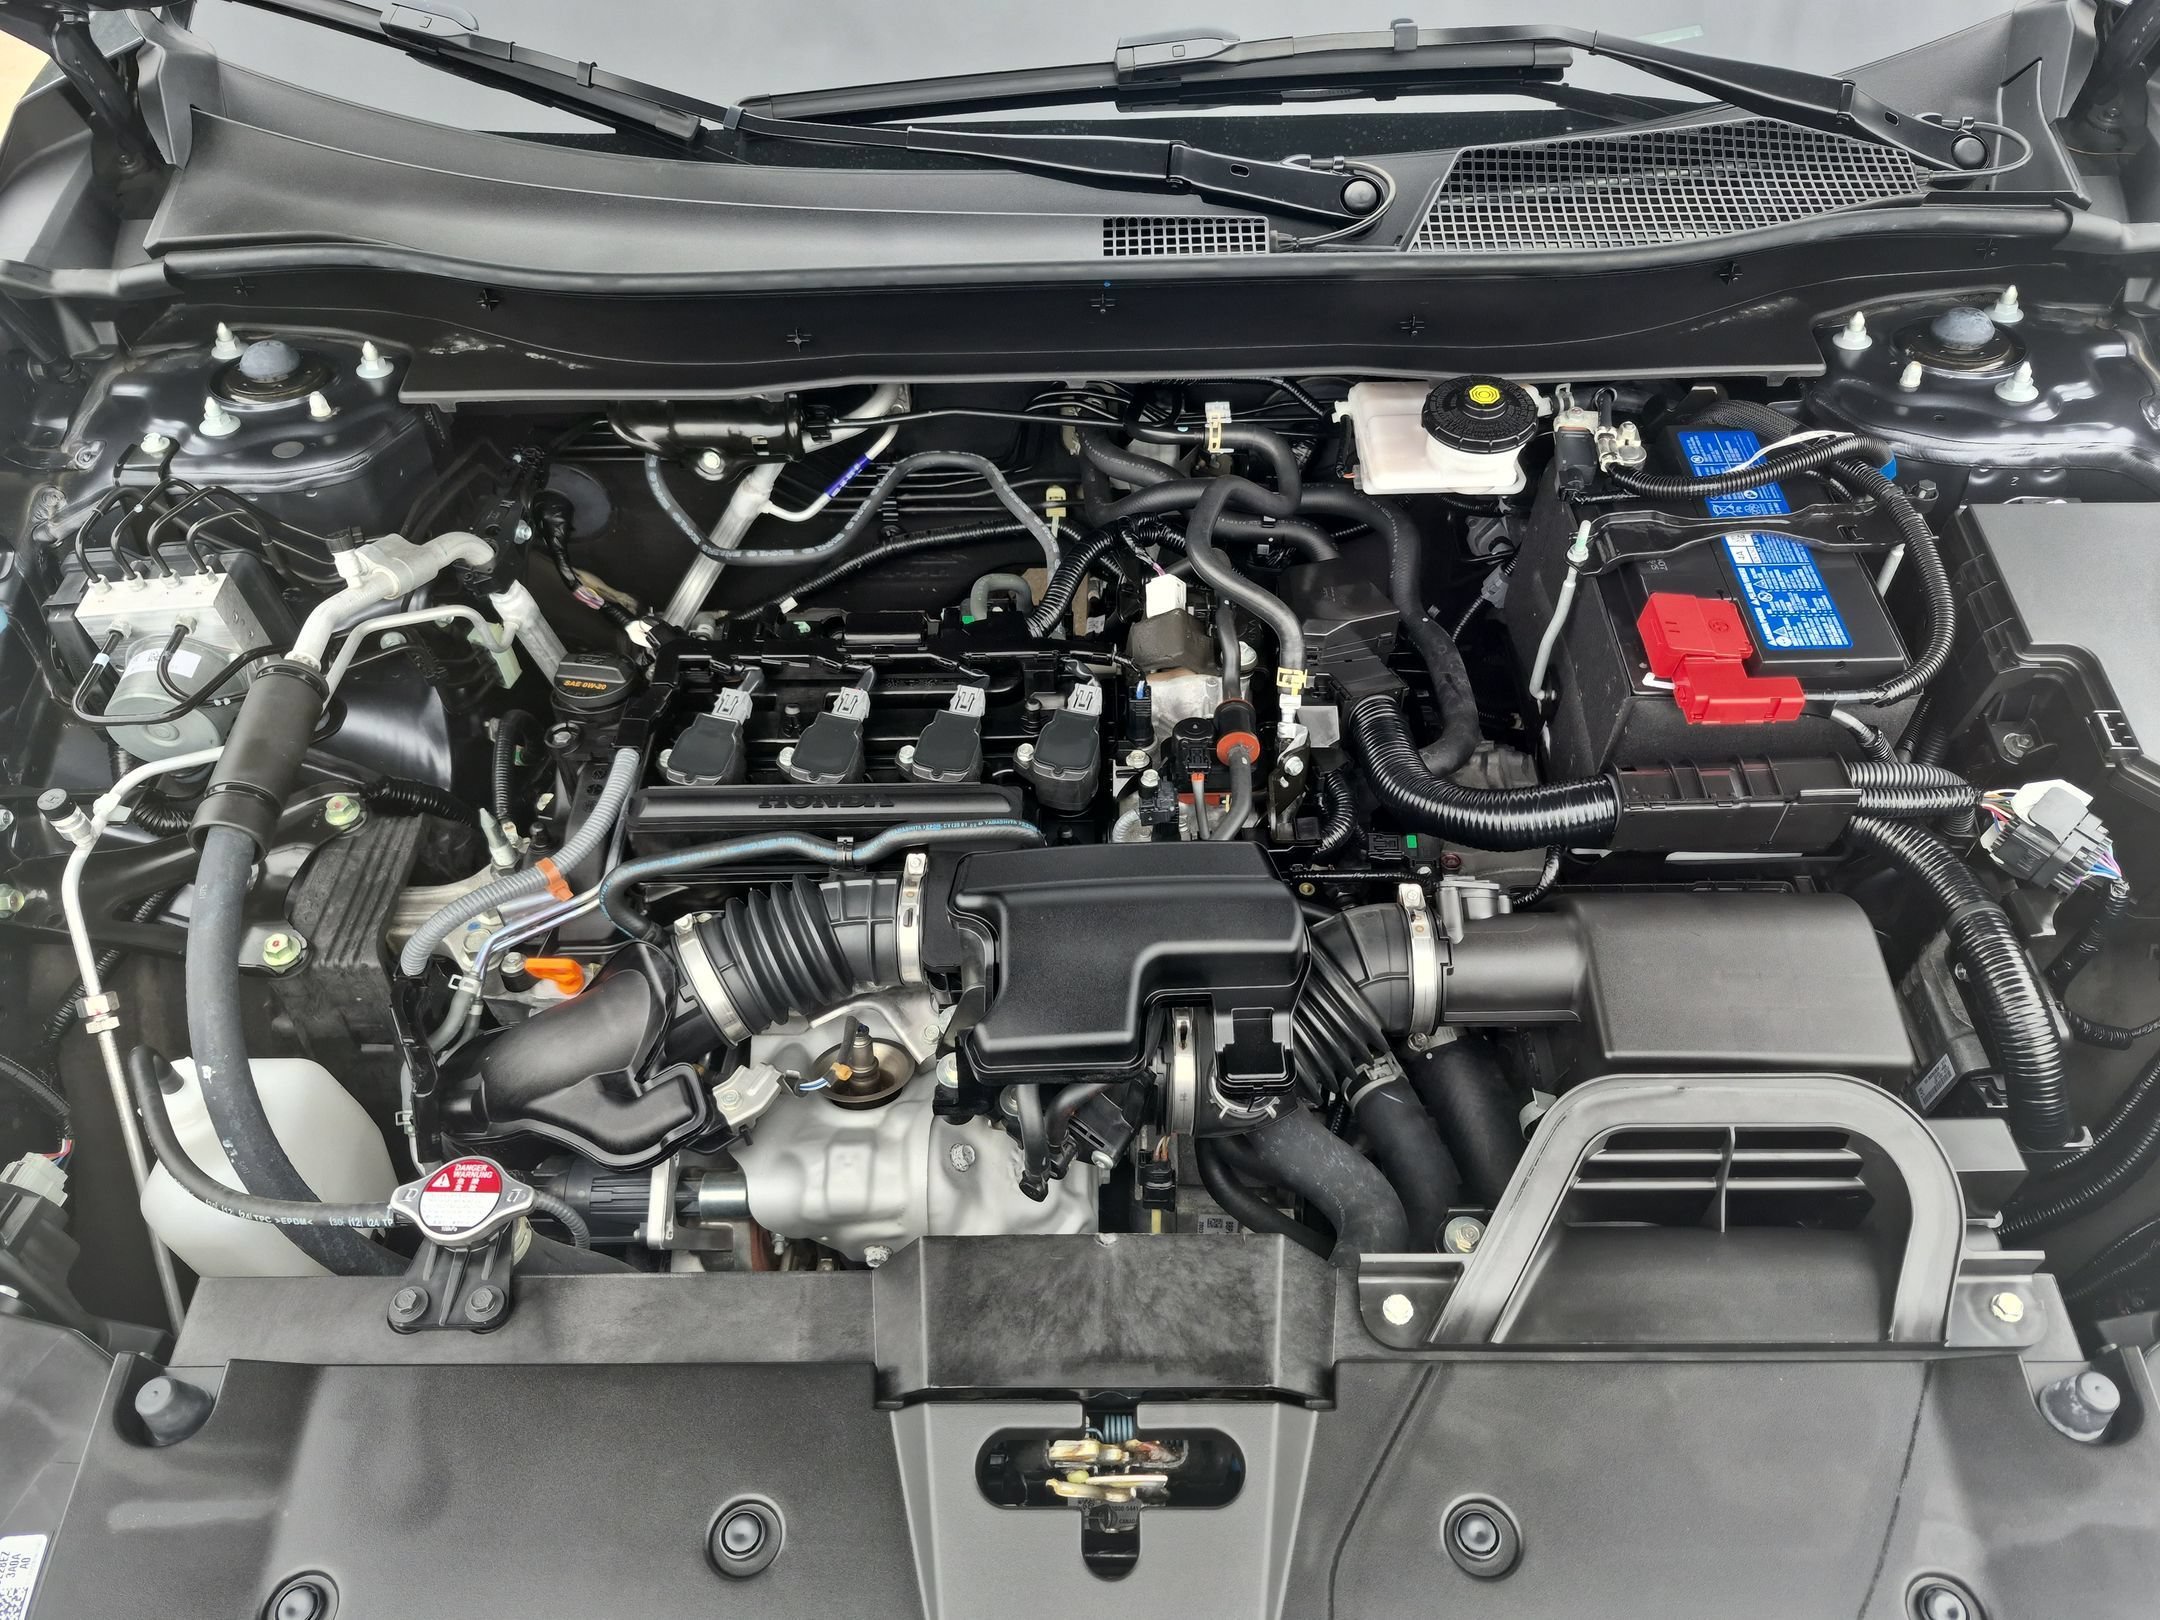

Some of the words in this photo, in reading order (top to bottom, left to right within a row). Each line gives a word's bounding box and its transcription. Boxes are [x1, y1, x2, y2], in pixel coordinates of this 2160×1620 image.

[563, 680, 582, 688] SAE
[758, 794, 894, 809] HONDA
[455, 1163, 489, 1172] DANGER
[453, 1171, 493, 1179] WARNUNG
